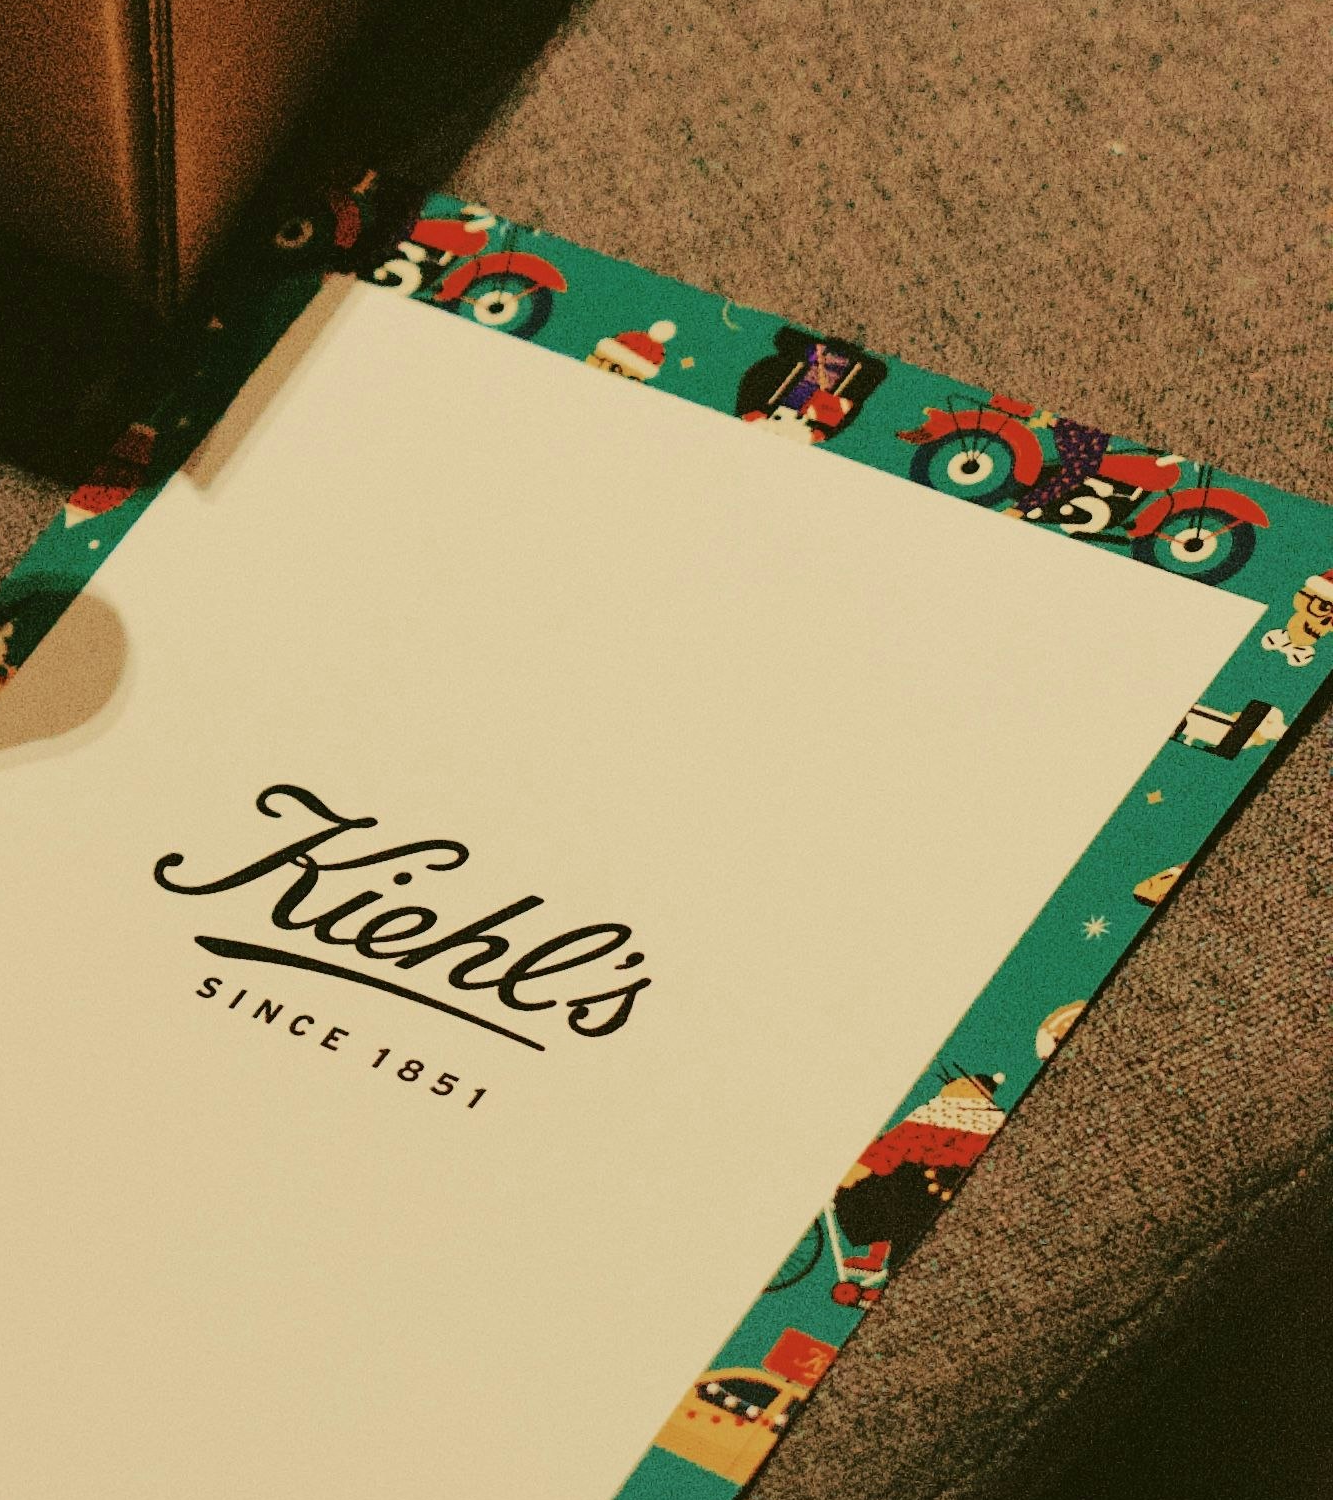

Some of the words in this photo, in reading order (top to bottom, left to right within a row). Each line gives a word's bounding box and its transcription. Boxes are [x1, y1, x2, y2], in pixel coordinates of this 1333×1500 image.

[153, 783, 652, 1038] Kiehl's
[195, 975, 350, 1053] SINCE
[372, 1045, 489, 1110] 1851
